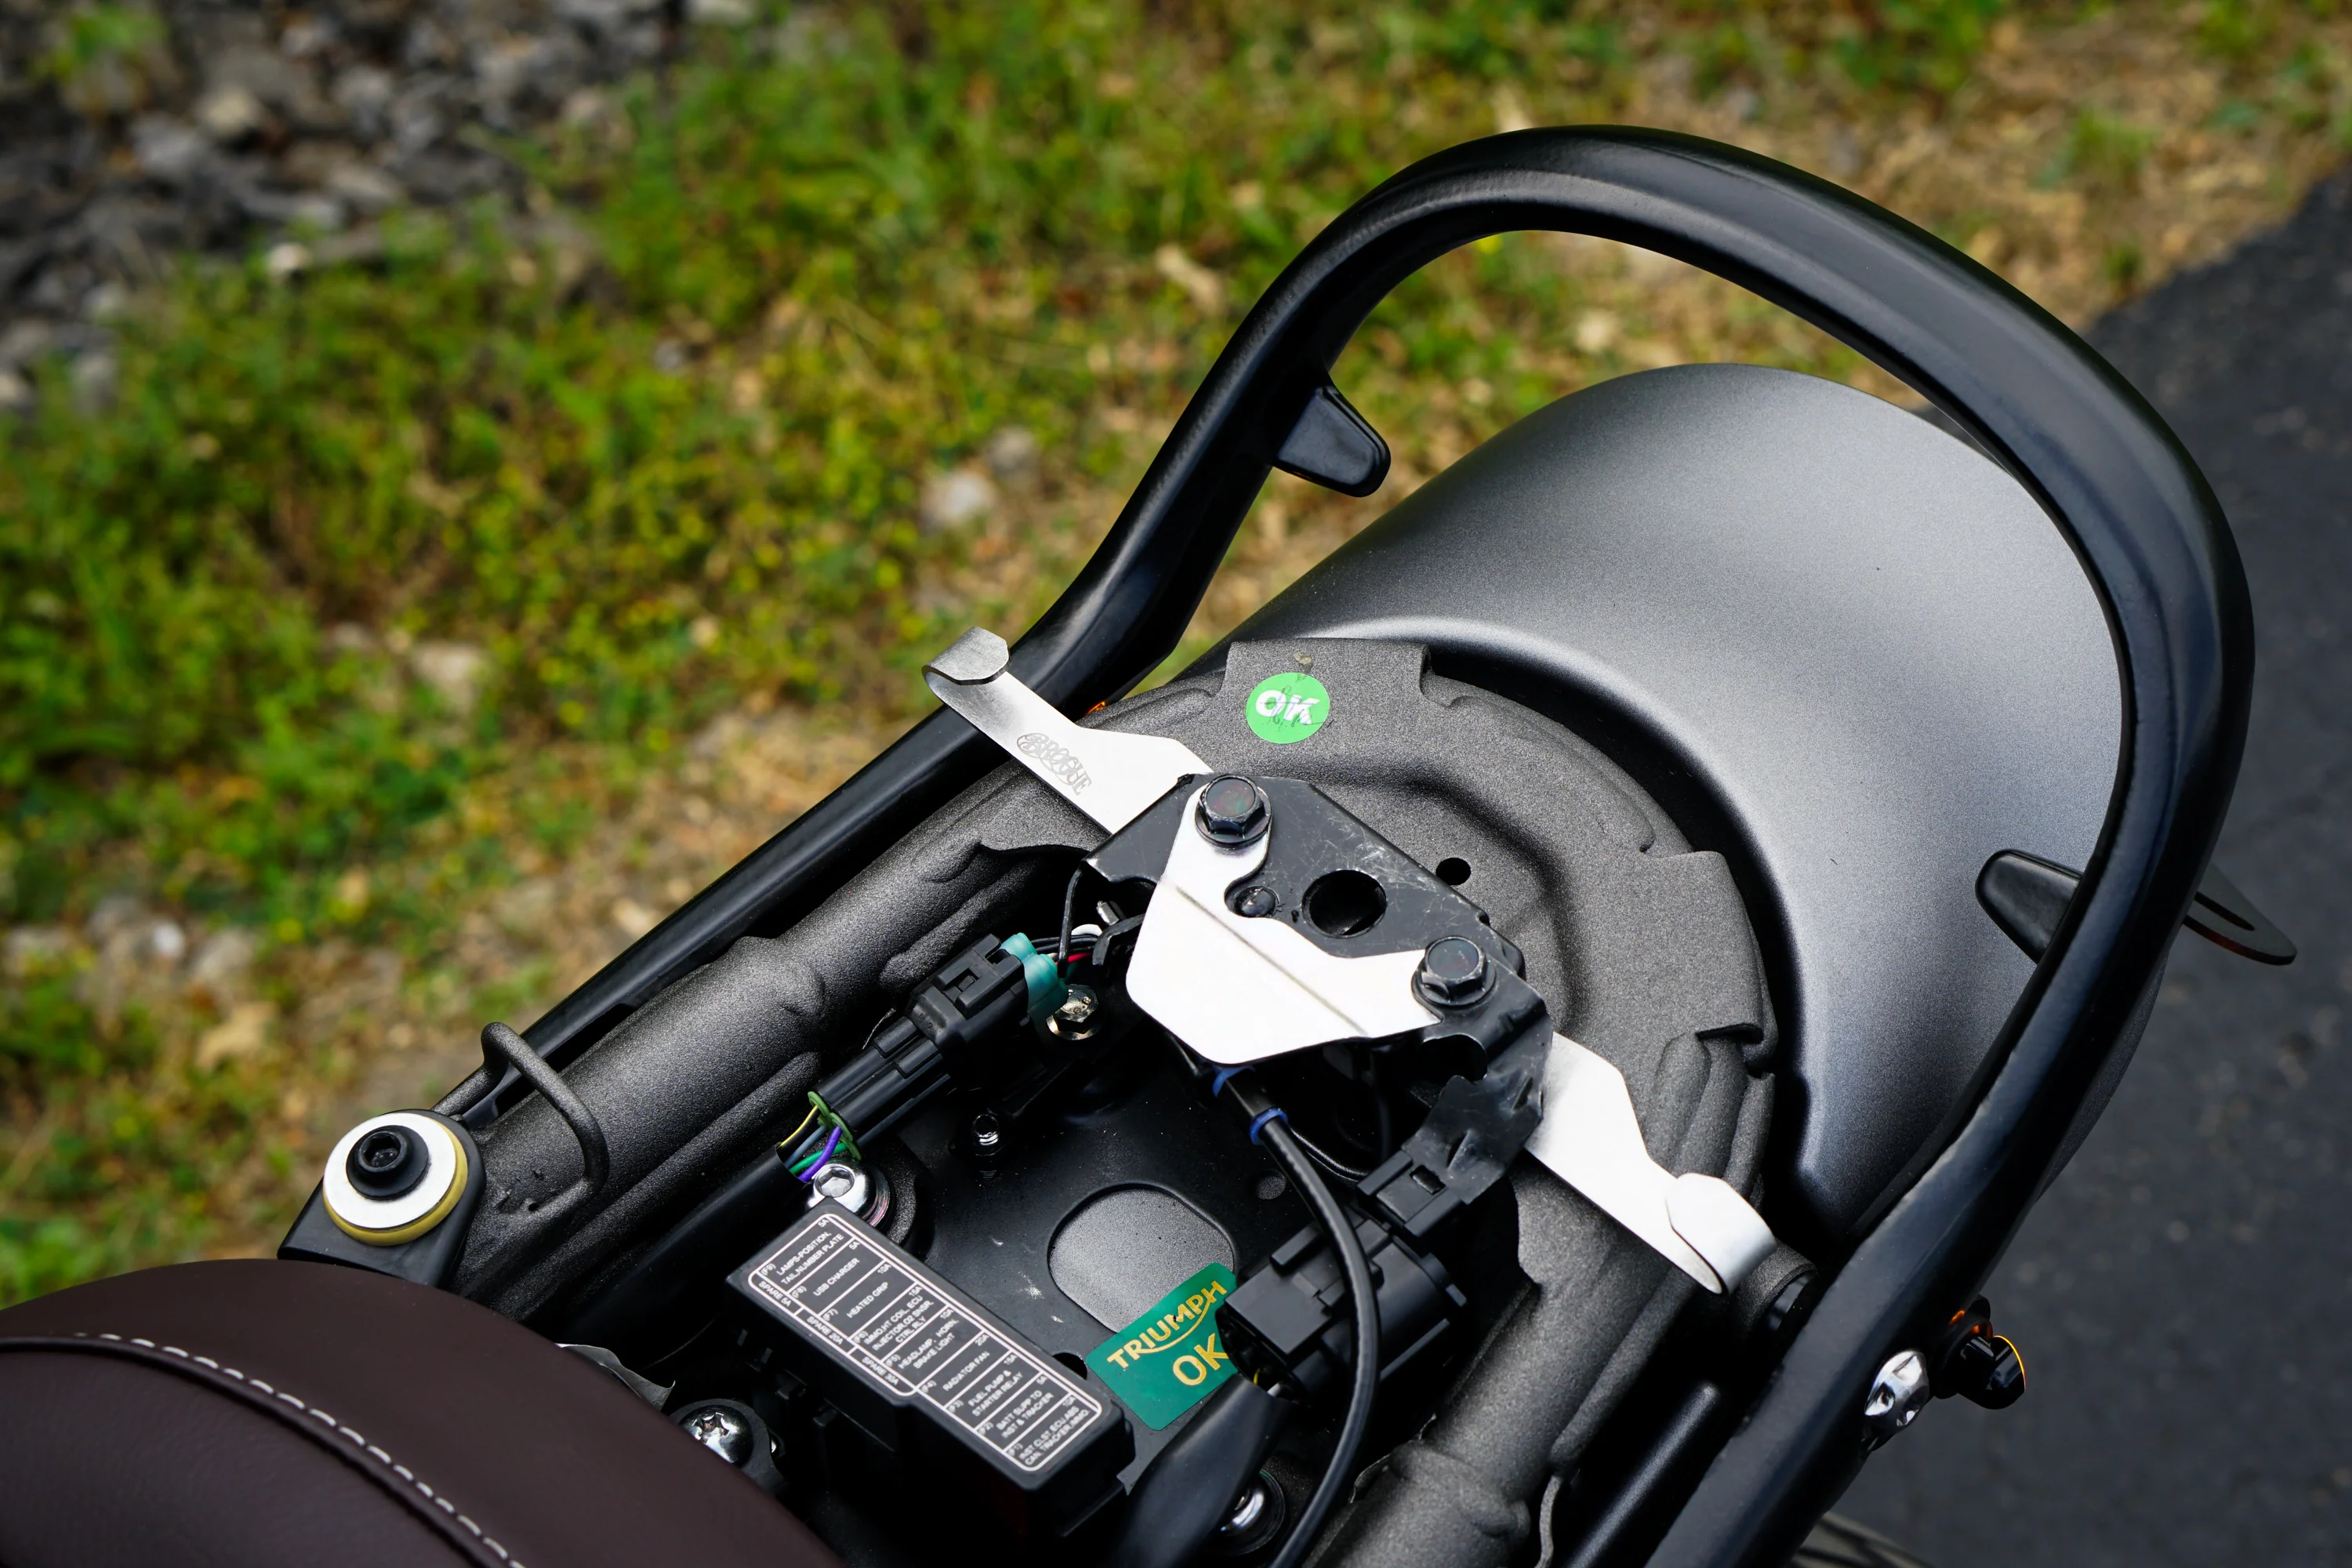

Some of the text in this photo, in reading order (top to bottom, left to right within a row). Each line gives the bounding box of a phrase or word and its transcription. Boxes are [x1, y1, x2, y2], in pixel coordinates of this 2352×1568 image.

[1255, 689, 1320, 725] OK
[821, 1233, 844, 1252] PLATE
[760, 1264, 776, 1275] (F9)
[812, 1258, 860, 1297] USB CHARGER
[759, 1280, 792, 1307] SPARE 5A
[793, 1286, 808, 1298] (F8)
[846, 1281, 888, 1319] HEATED GRIP
[906, 1295, 924, 1309] ECU
[824, 1308, 839, 1321] (F7)
[1107, 1280, 1227, 1369] TRIUMPH
[807, 1316, 844, 1345] SPARE 20A
[975, 1334, 989, 1346] 20A
[913, 1332, 955, 1369] BRAKE LIGHT
[1172, 1333, 1229, 1386] OK
[862, 1356, 887, 1377] SPARE
[942, 1351, 990, 1392] RADIATOR FAN
[1036, 1376, 1048, 1385] 5A
[967, 1392, 989, 1406] FUEL
[984, 1374, 1004, 1392] PUMP
[971, 1371, 1023, 1417] STARTER RELAY
[1029, 1389, 1043, 1400] TO
